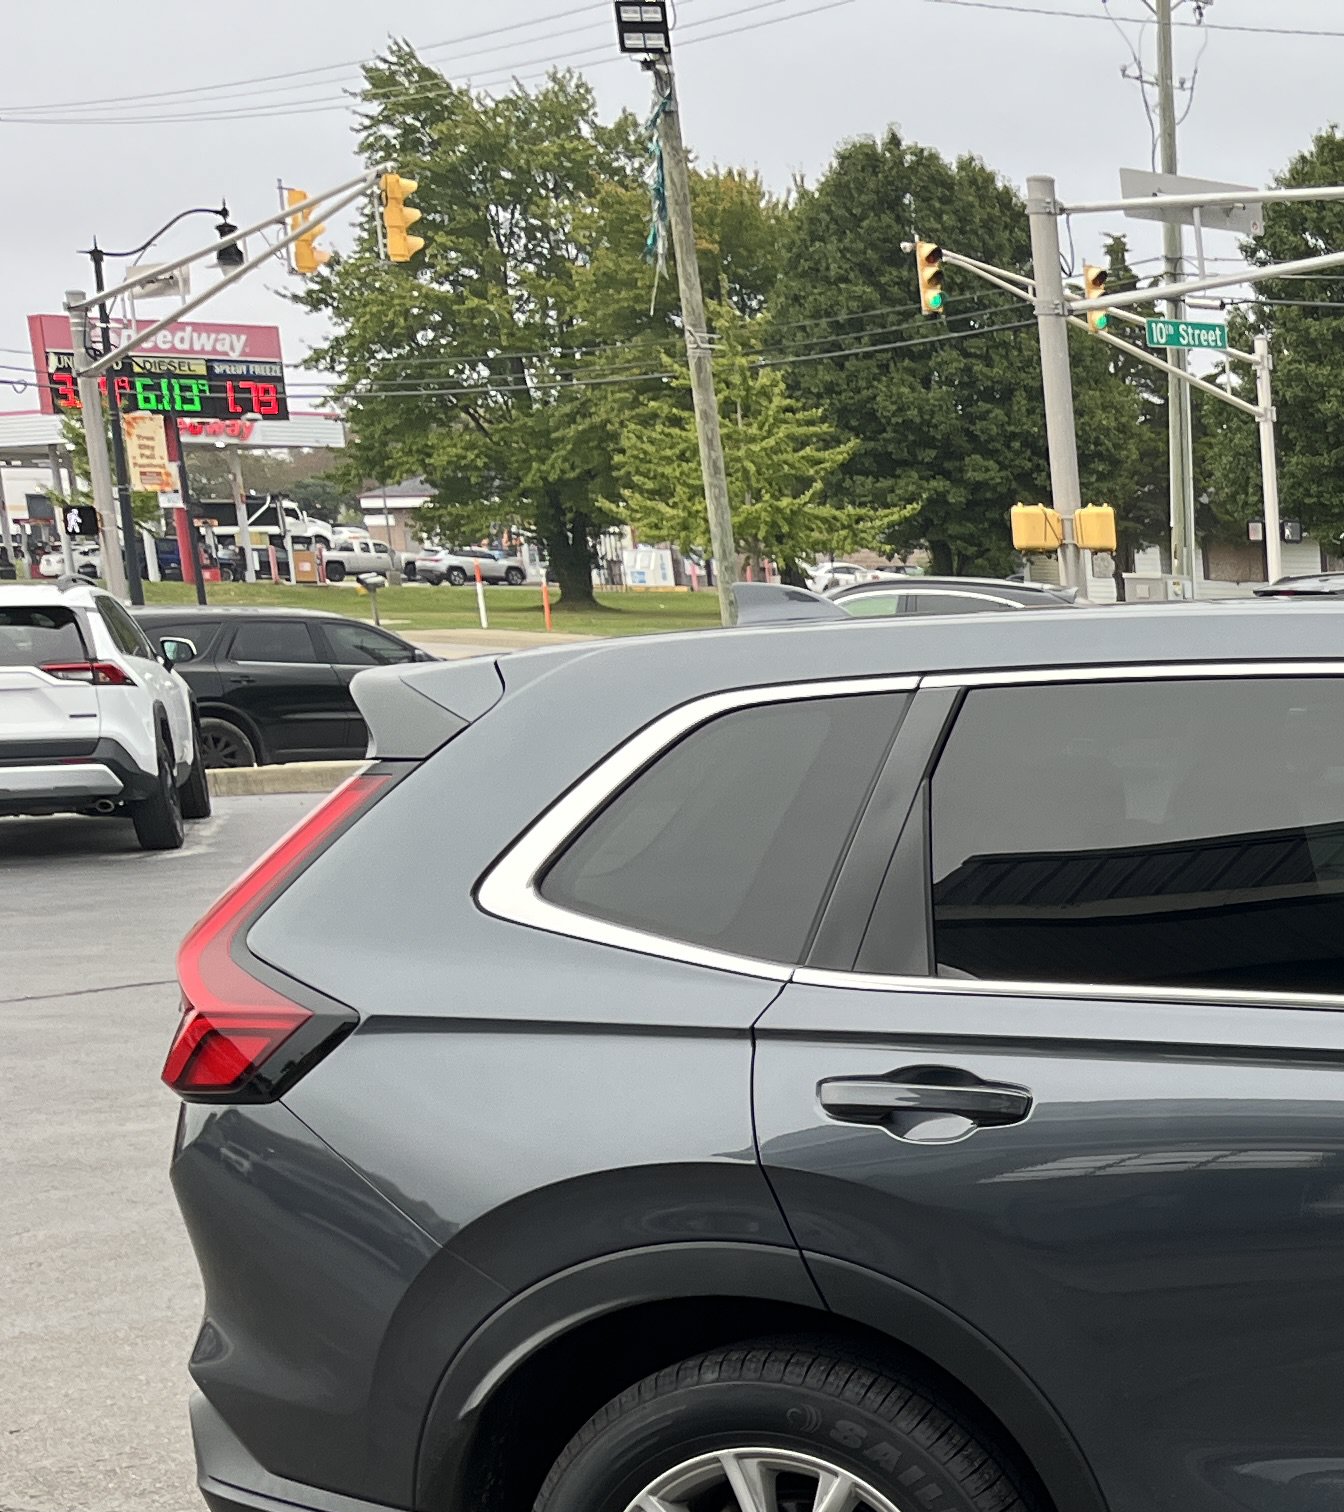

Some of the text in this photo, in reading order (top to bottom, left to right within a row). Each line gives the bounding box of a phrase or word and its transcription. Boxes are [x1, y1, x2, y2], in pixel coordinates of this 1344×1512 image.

[1151, 322, 1223, 347] 10th Street
[143, 359, 197, 373] DIESEL
